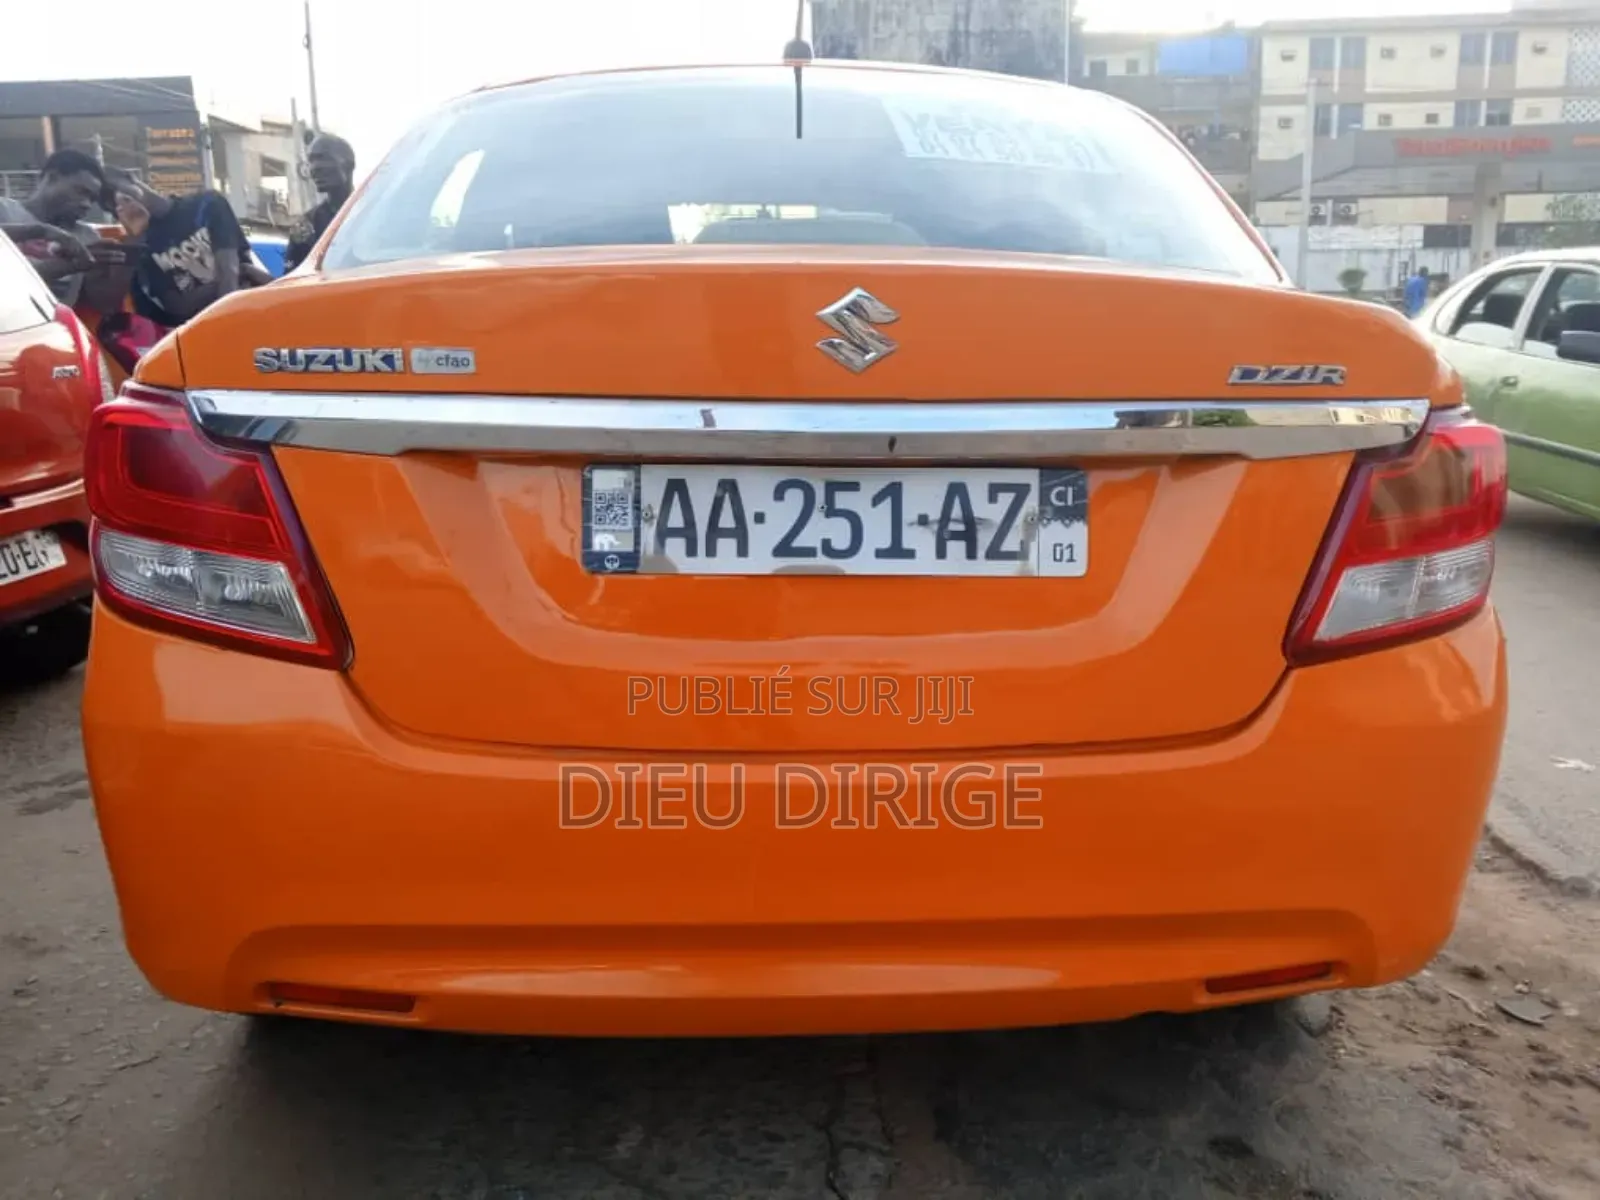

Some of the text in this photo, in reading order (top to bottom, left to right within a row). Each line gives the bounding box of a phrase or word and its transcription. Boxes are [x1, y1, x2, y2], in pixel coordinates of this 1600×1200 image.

[253, 347, 404, 373] SUZUKI
[435, 354, 470, 368] cfao
[1050, 486, 1073, 506] CI
[1053, 542, 1077, 563] 01
